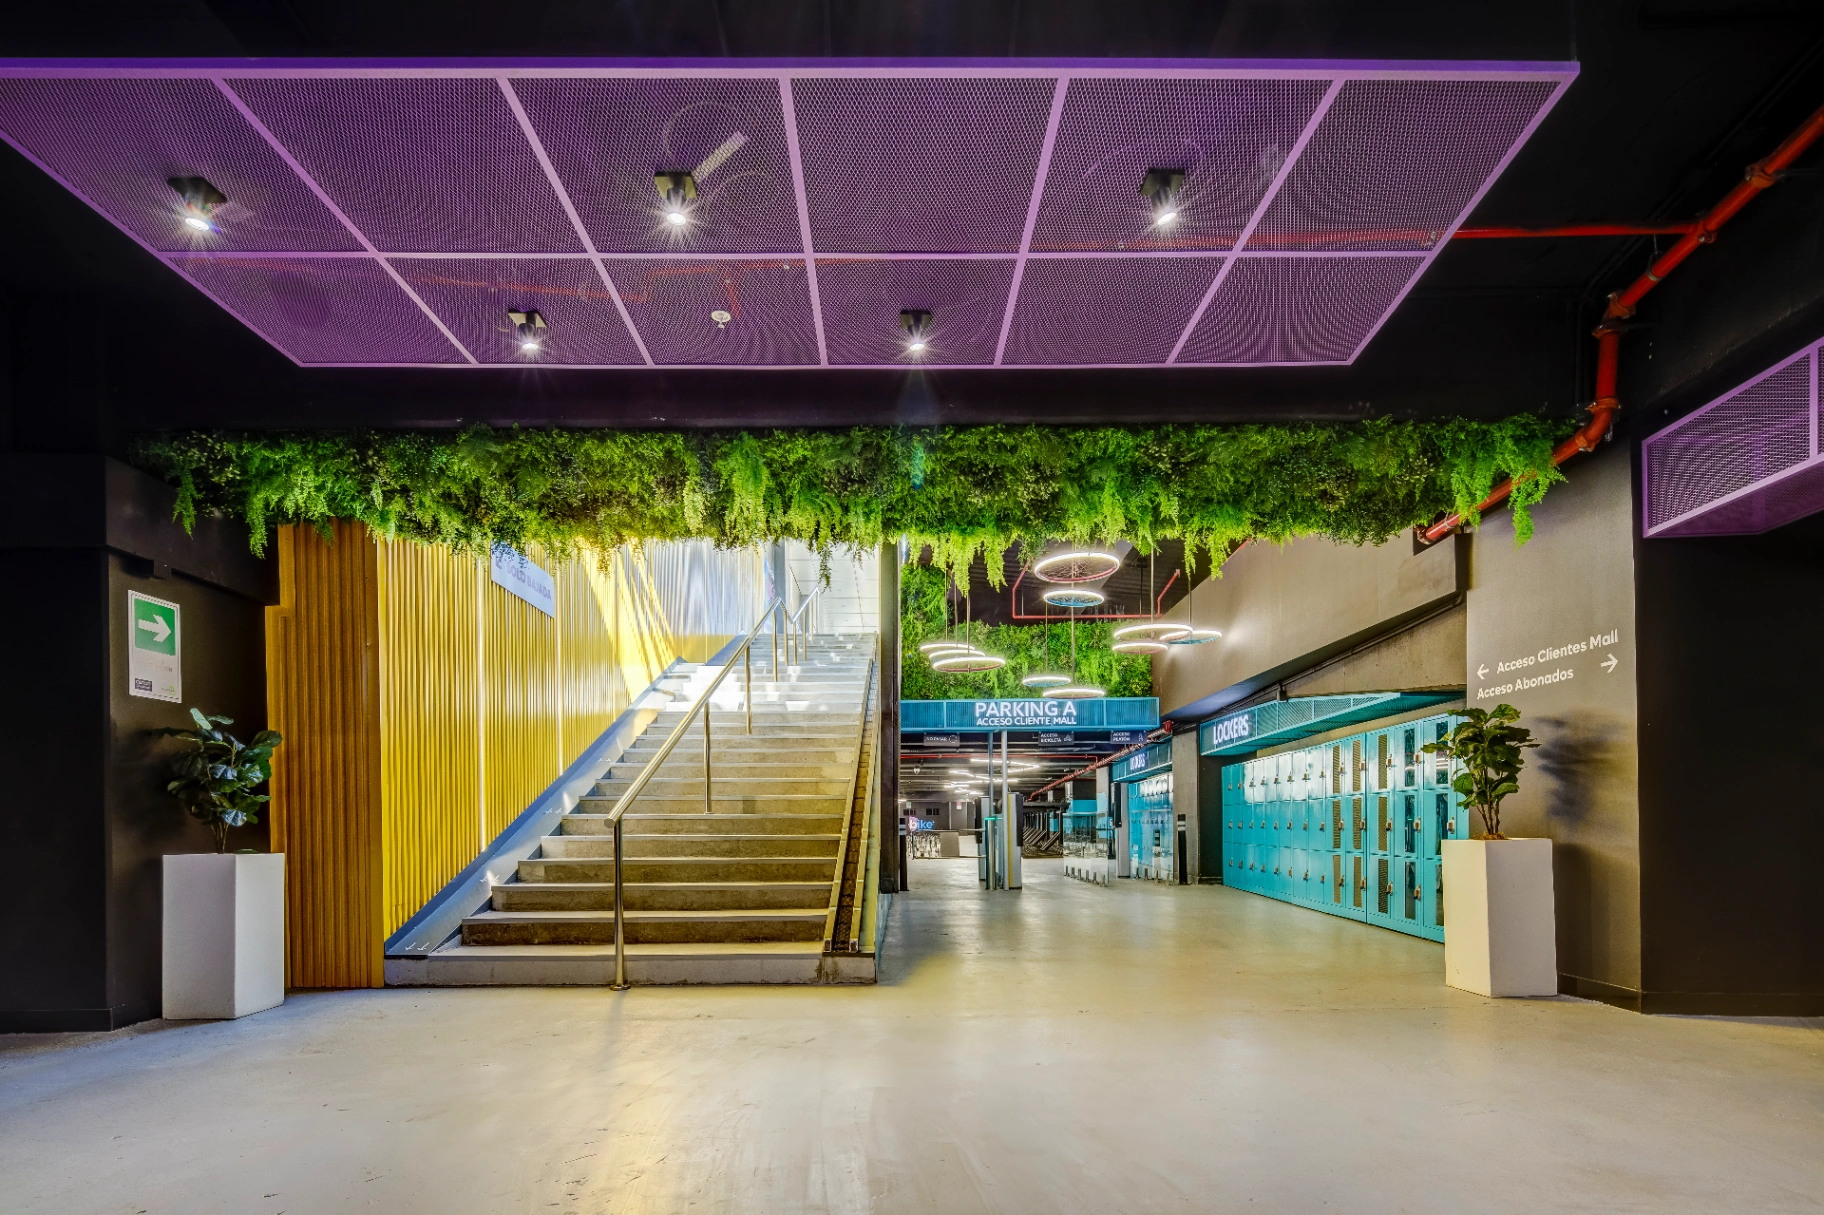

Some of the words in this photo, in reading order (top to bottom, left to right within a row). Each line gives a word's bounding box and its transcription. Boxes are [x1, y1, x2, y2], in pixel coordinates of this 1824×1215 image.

[526, 574, 552, 601] BAJADA
[1496, 656, 1535, 674] Acceso
[1537, 640, 1587, 663] Clientes
[1589, 628, 1619, 650] Mall
[1477, 682, 1513, 700] Acceso
[1514, 668, 1574, 692] Abonados
[975, 701, 1058, 717] PARKING
[1062, 701, 1077, 716] A
[976, 717, 1013, 726] ACCESO
[1014, 716, 1051, 725] CLIENTE
[1053, 716, 1077, 725] MALL
[1213, 714, 1249, 745] LOCKERS
